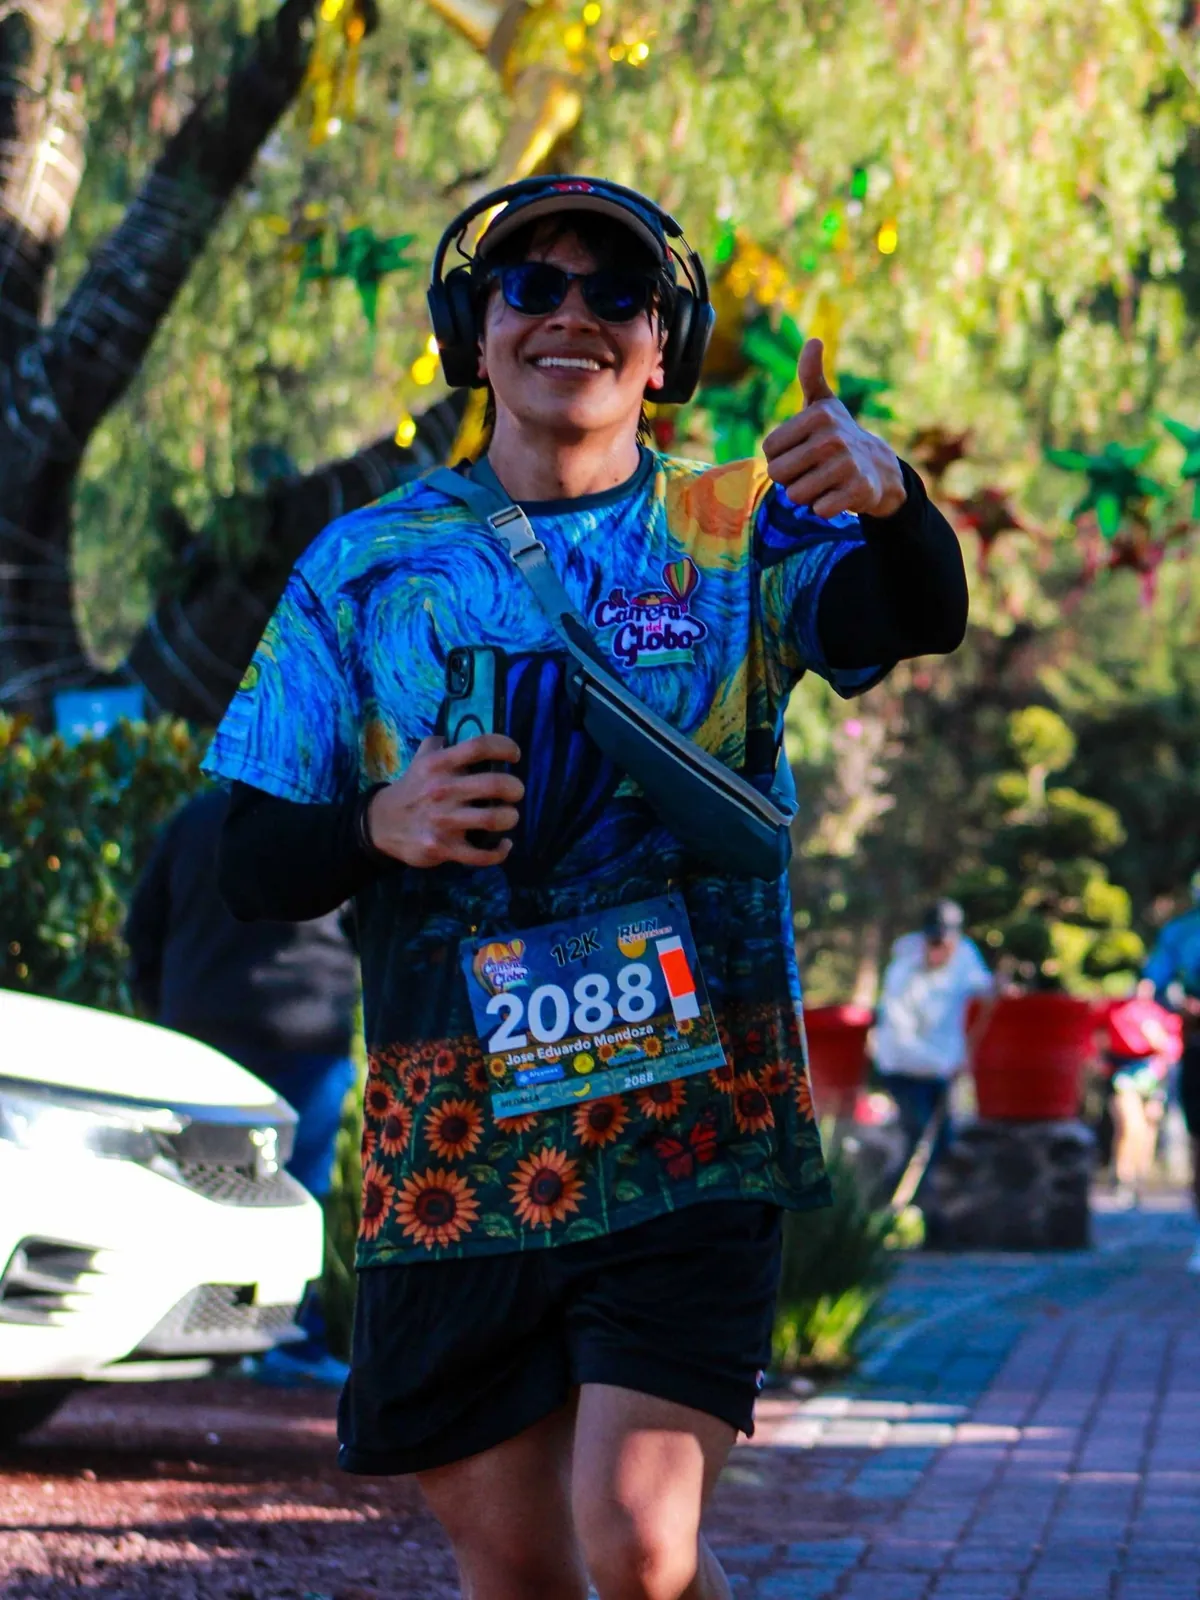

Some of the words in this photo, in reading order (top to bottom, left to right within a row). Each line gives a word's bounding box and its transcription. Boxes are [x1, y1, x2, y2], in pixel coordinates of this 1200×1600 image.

[595, 602, 680, 626] Carrera
[645, 619, 662, 631] del
[615, 621, 706, 666] Globo
[617, 916, 659, 938] RUN
[551, 927, 603, 967] 12K
[485, 962, 657, 1053] 2088
[506, 1052, 535, 1067] Jose
[536, 1038, 592, 1060] Eduardo
[593, 1023, 655, 1048] Mendoza
[624, 1071, 655, 1089] 2088
